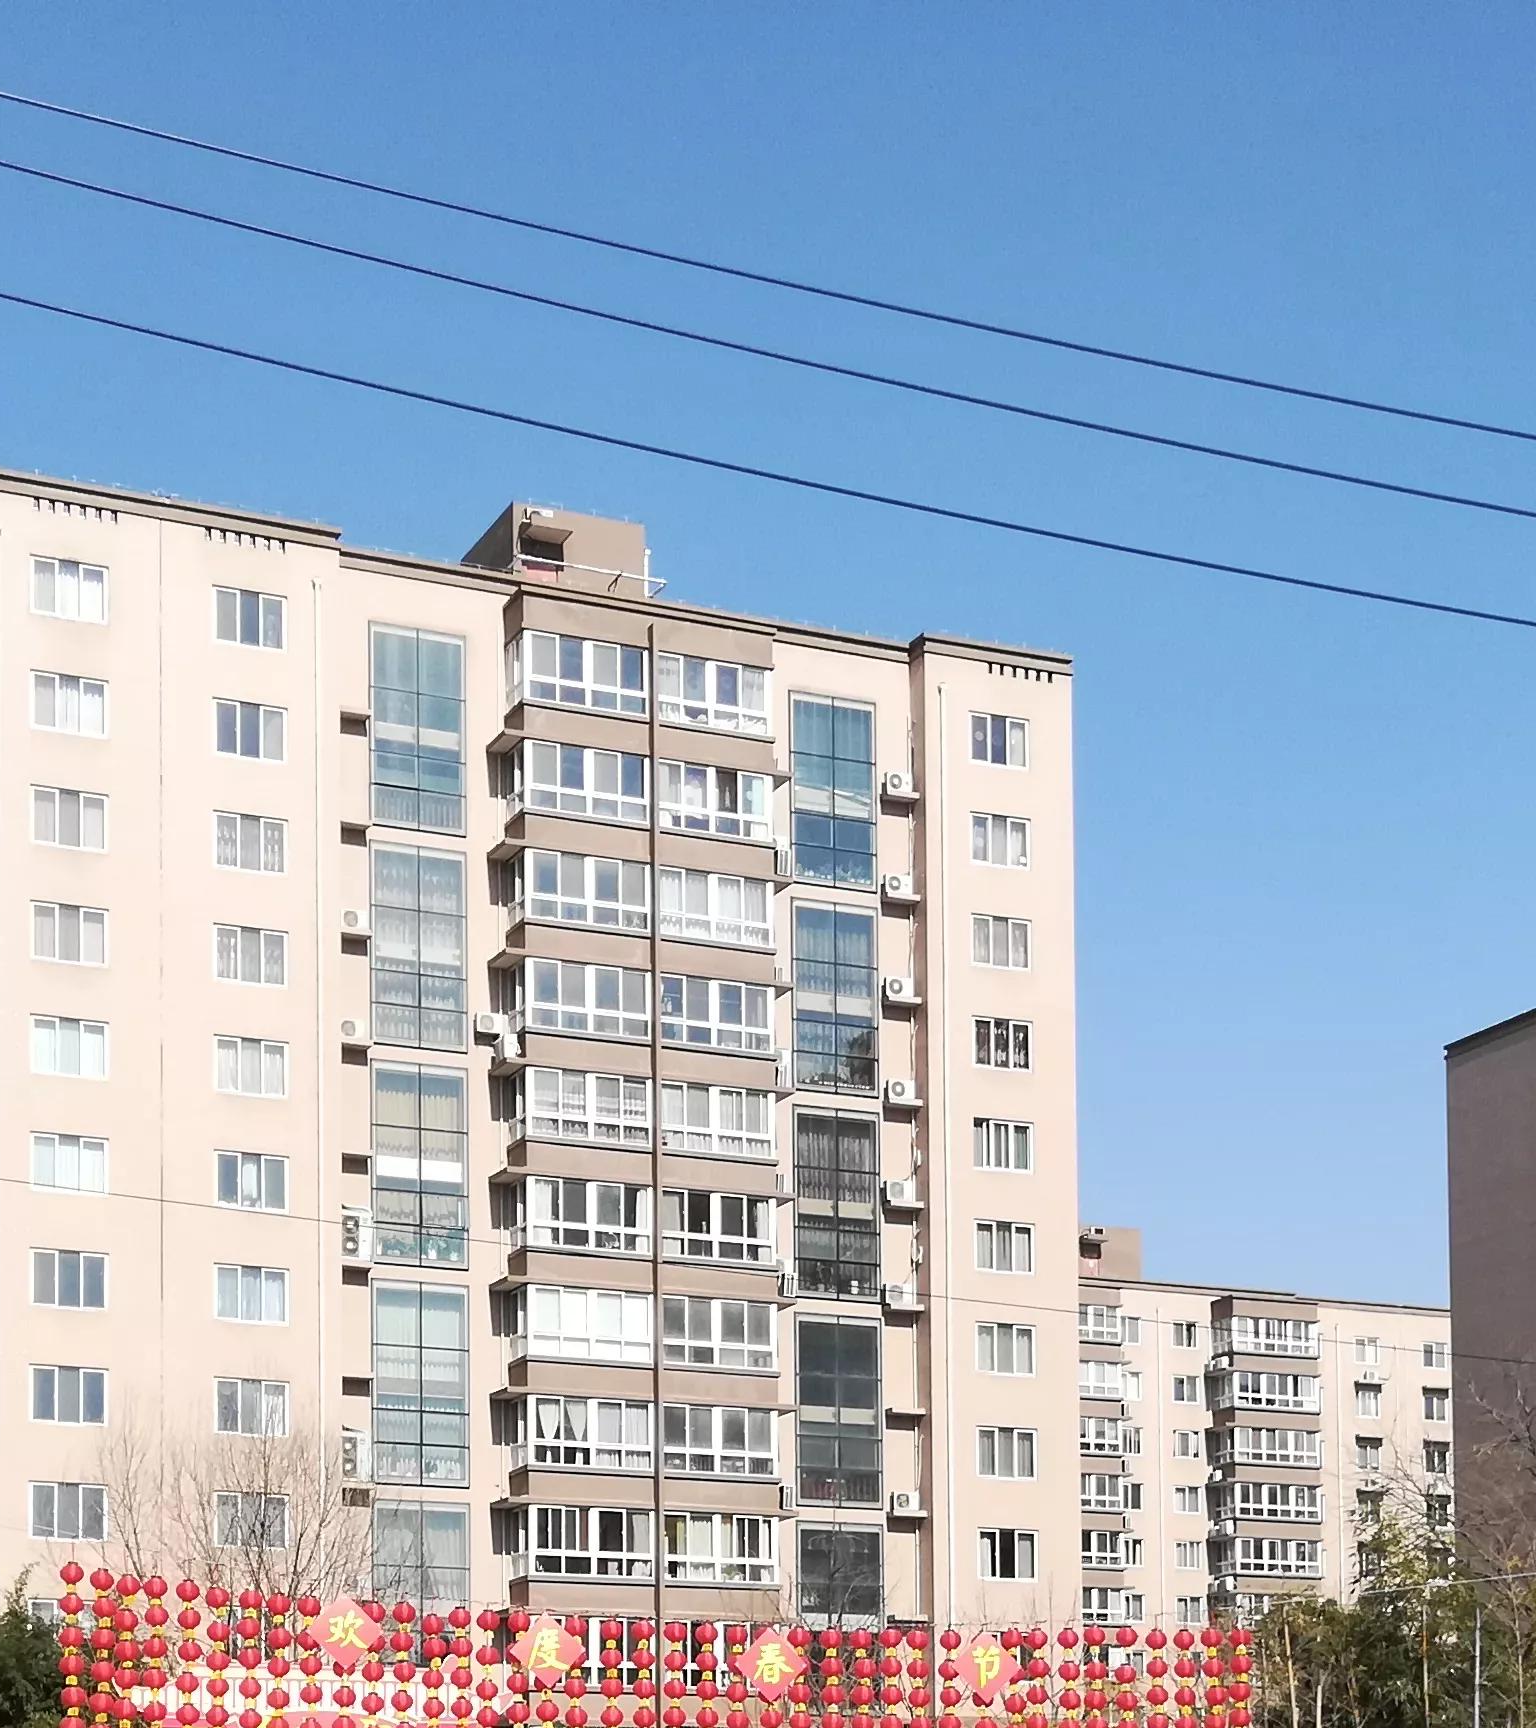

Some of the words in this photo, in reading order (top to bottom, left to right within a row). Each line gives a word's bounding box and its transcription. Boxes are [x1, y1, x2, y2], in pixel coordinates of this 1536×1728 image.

[326, 1610, 367, 1650] 欢
[527, 1631, 563, 1673] 度
[753, 1644, 794, 1686] 春
[971, 1645, 1006, 1689] 节
